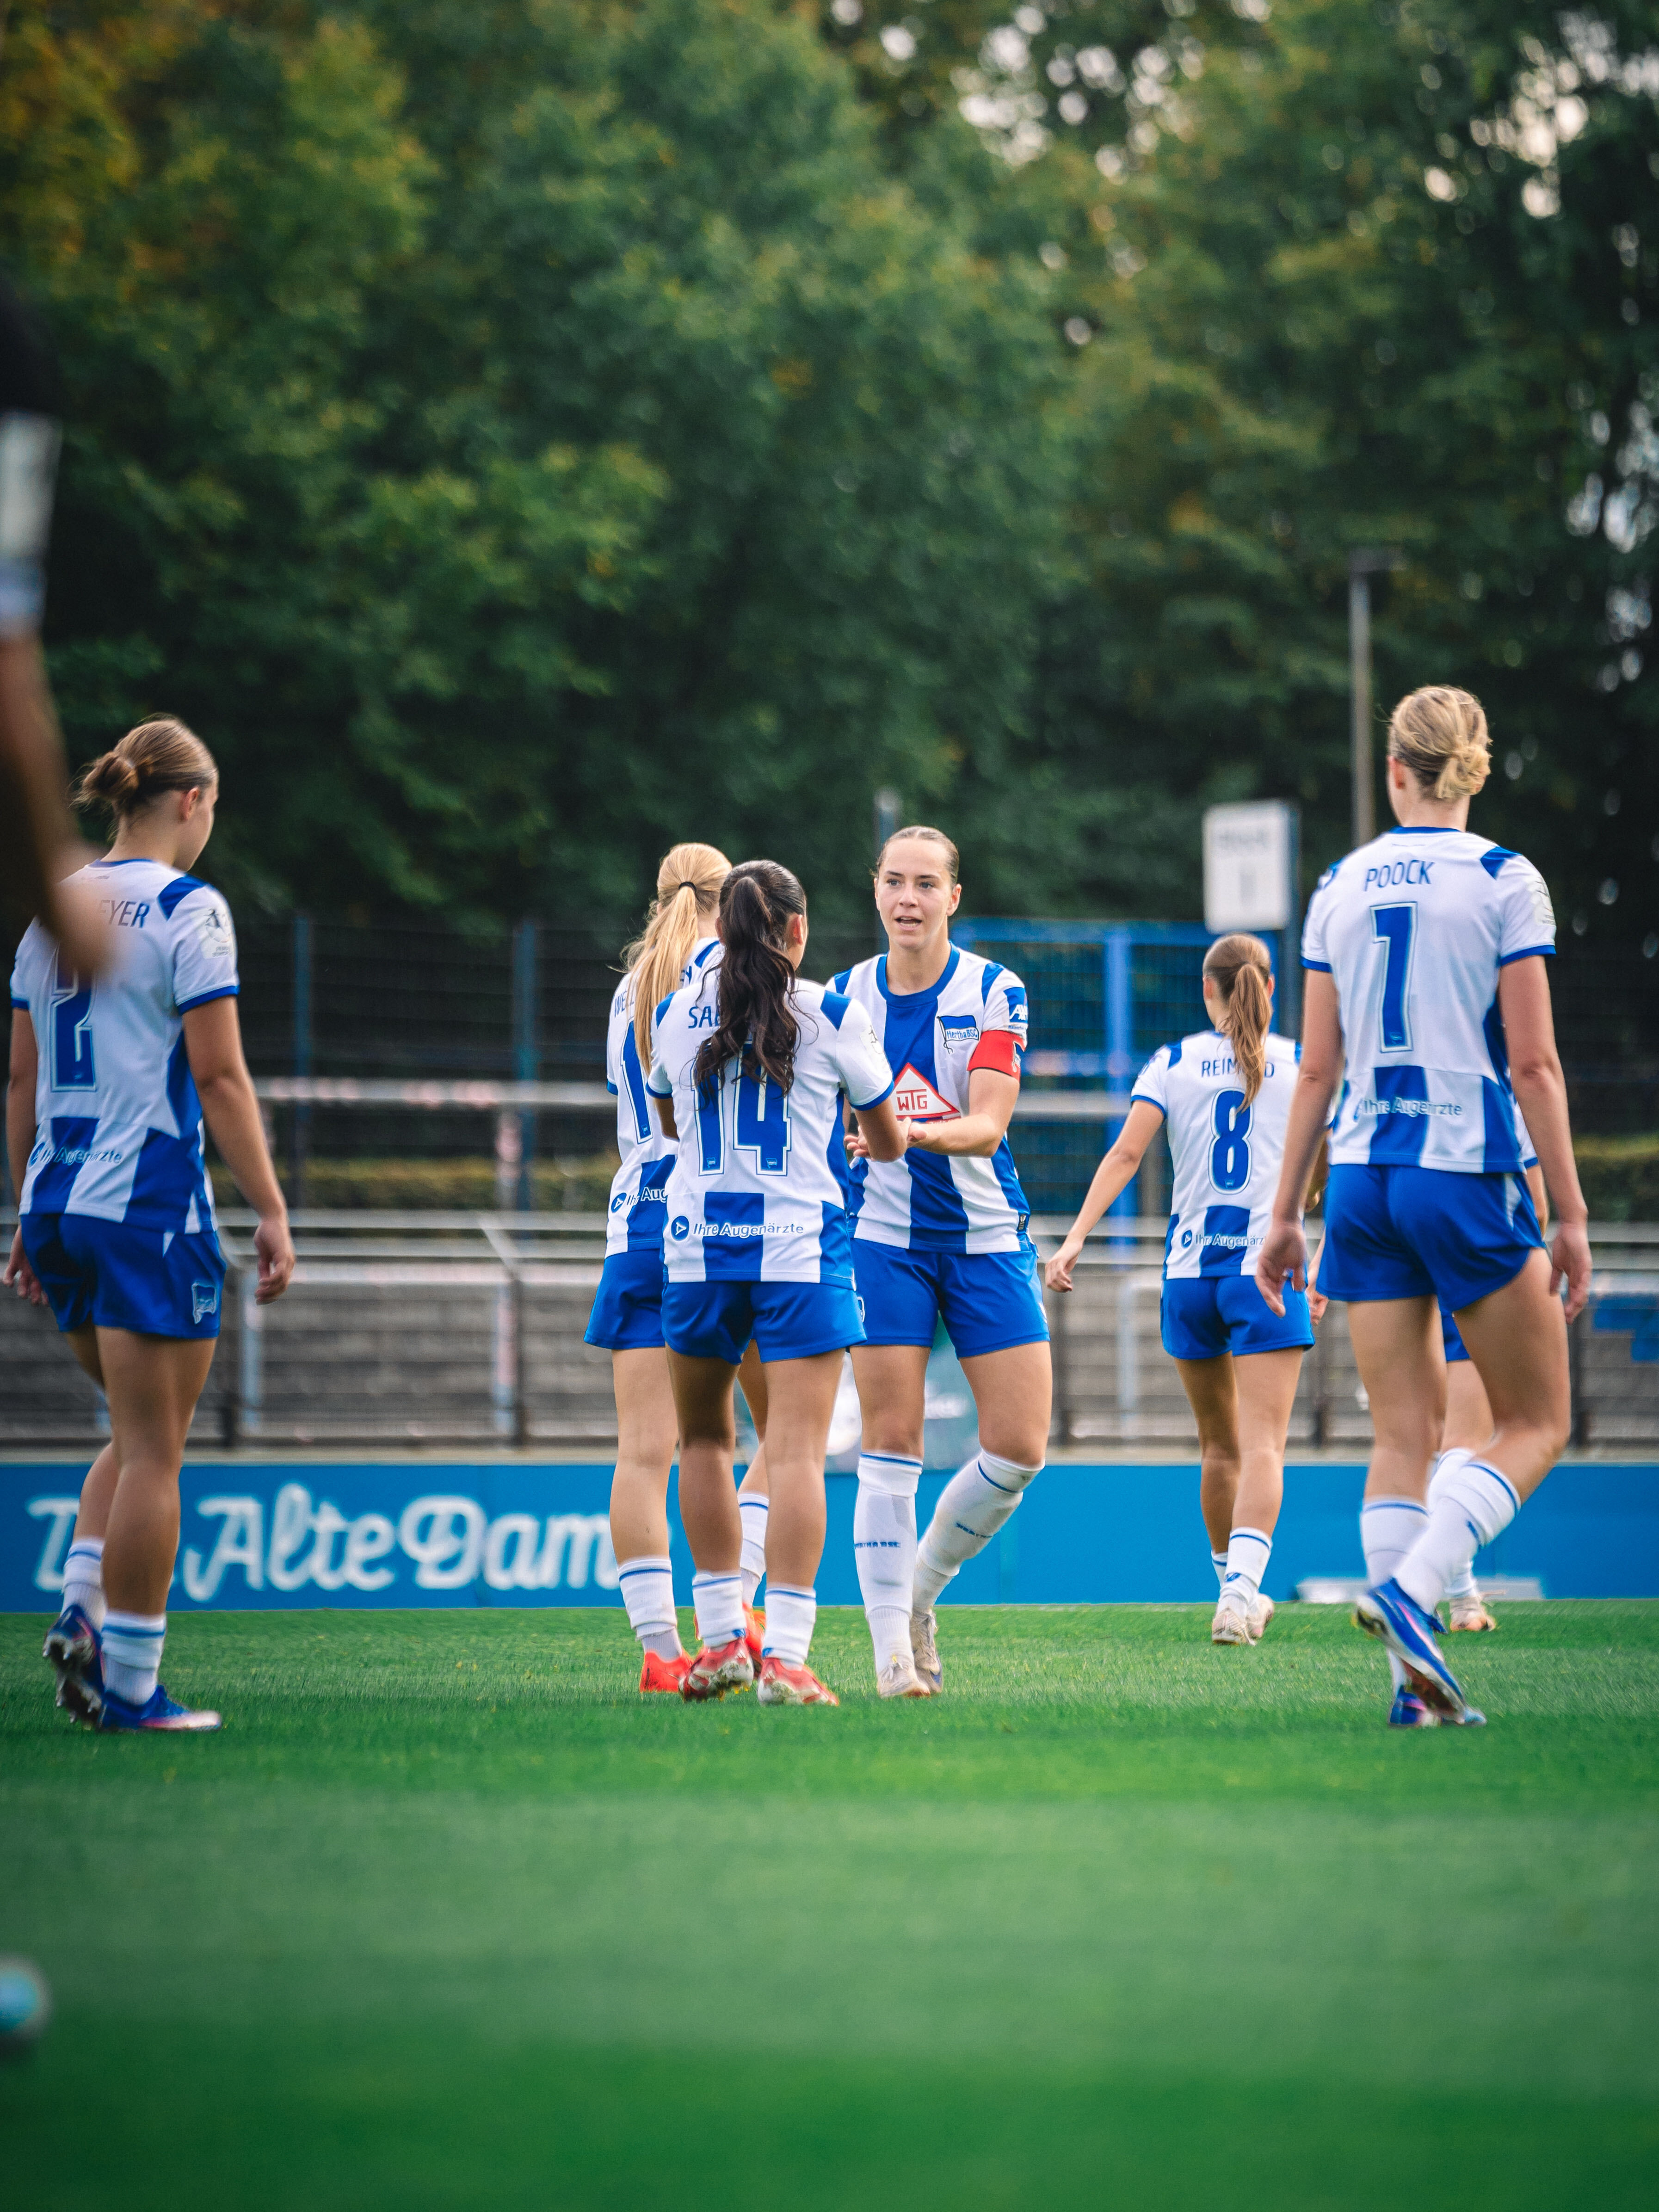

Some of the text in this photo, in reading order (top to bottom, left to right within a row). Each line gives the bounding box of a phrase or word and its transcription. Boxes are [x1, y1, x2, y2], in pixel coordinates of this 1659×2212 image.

[1364, 859, 1435, 892] POOCK
[1369, 901, 1418, 1053] 1
[690, 1038, 791, 1176] 14
[896, 1088, 928, 1111] WTG
[1208, 1088, 1253, 1195] 8
[693, 1222, 804, 1238] Ihre Augenärzte
[1212, 1233, 1264, 1250] Augenärz
[182, 1482, 397, 1603] Alte
[398, 1494, 619, 1591] Dam
